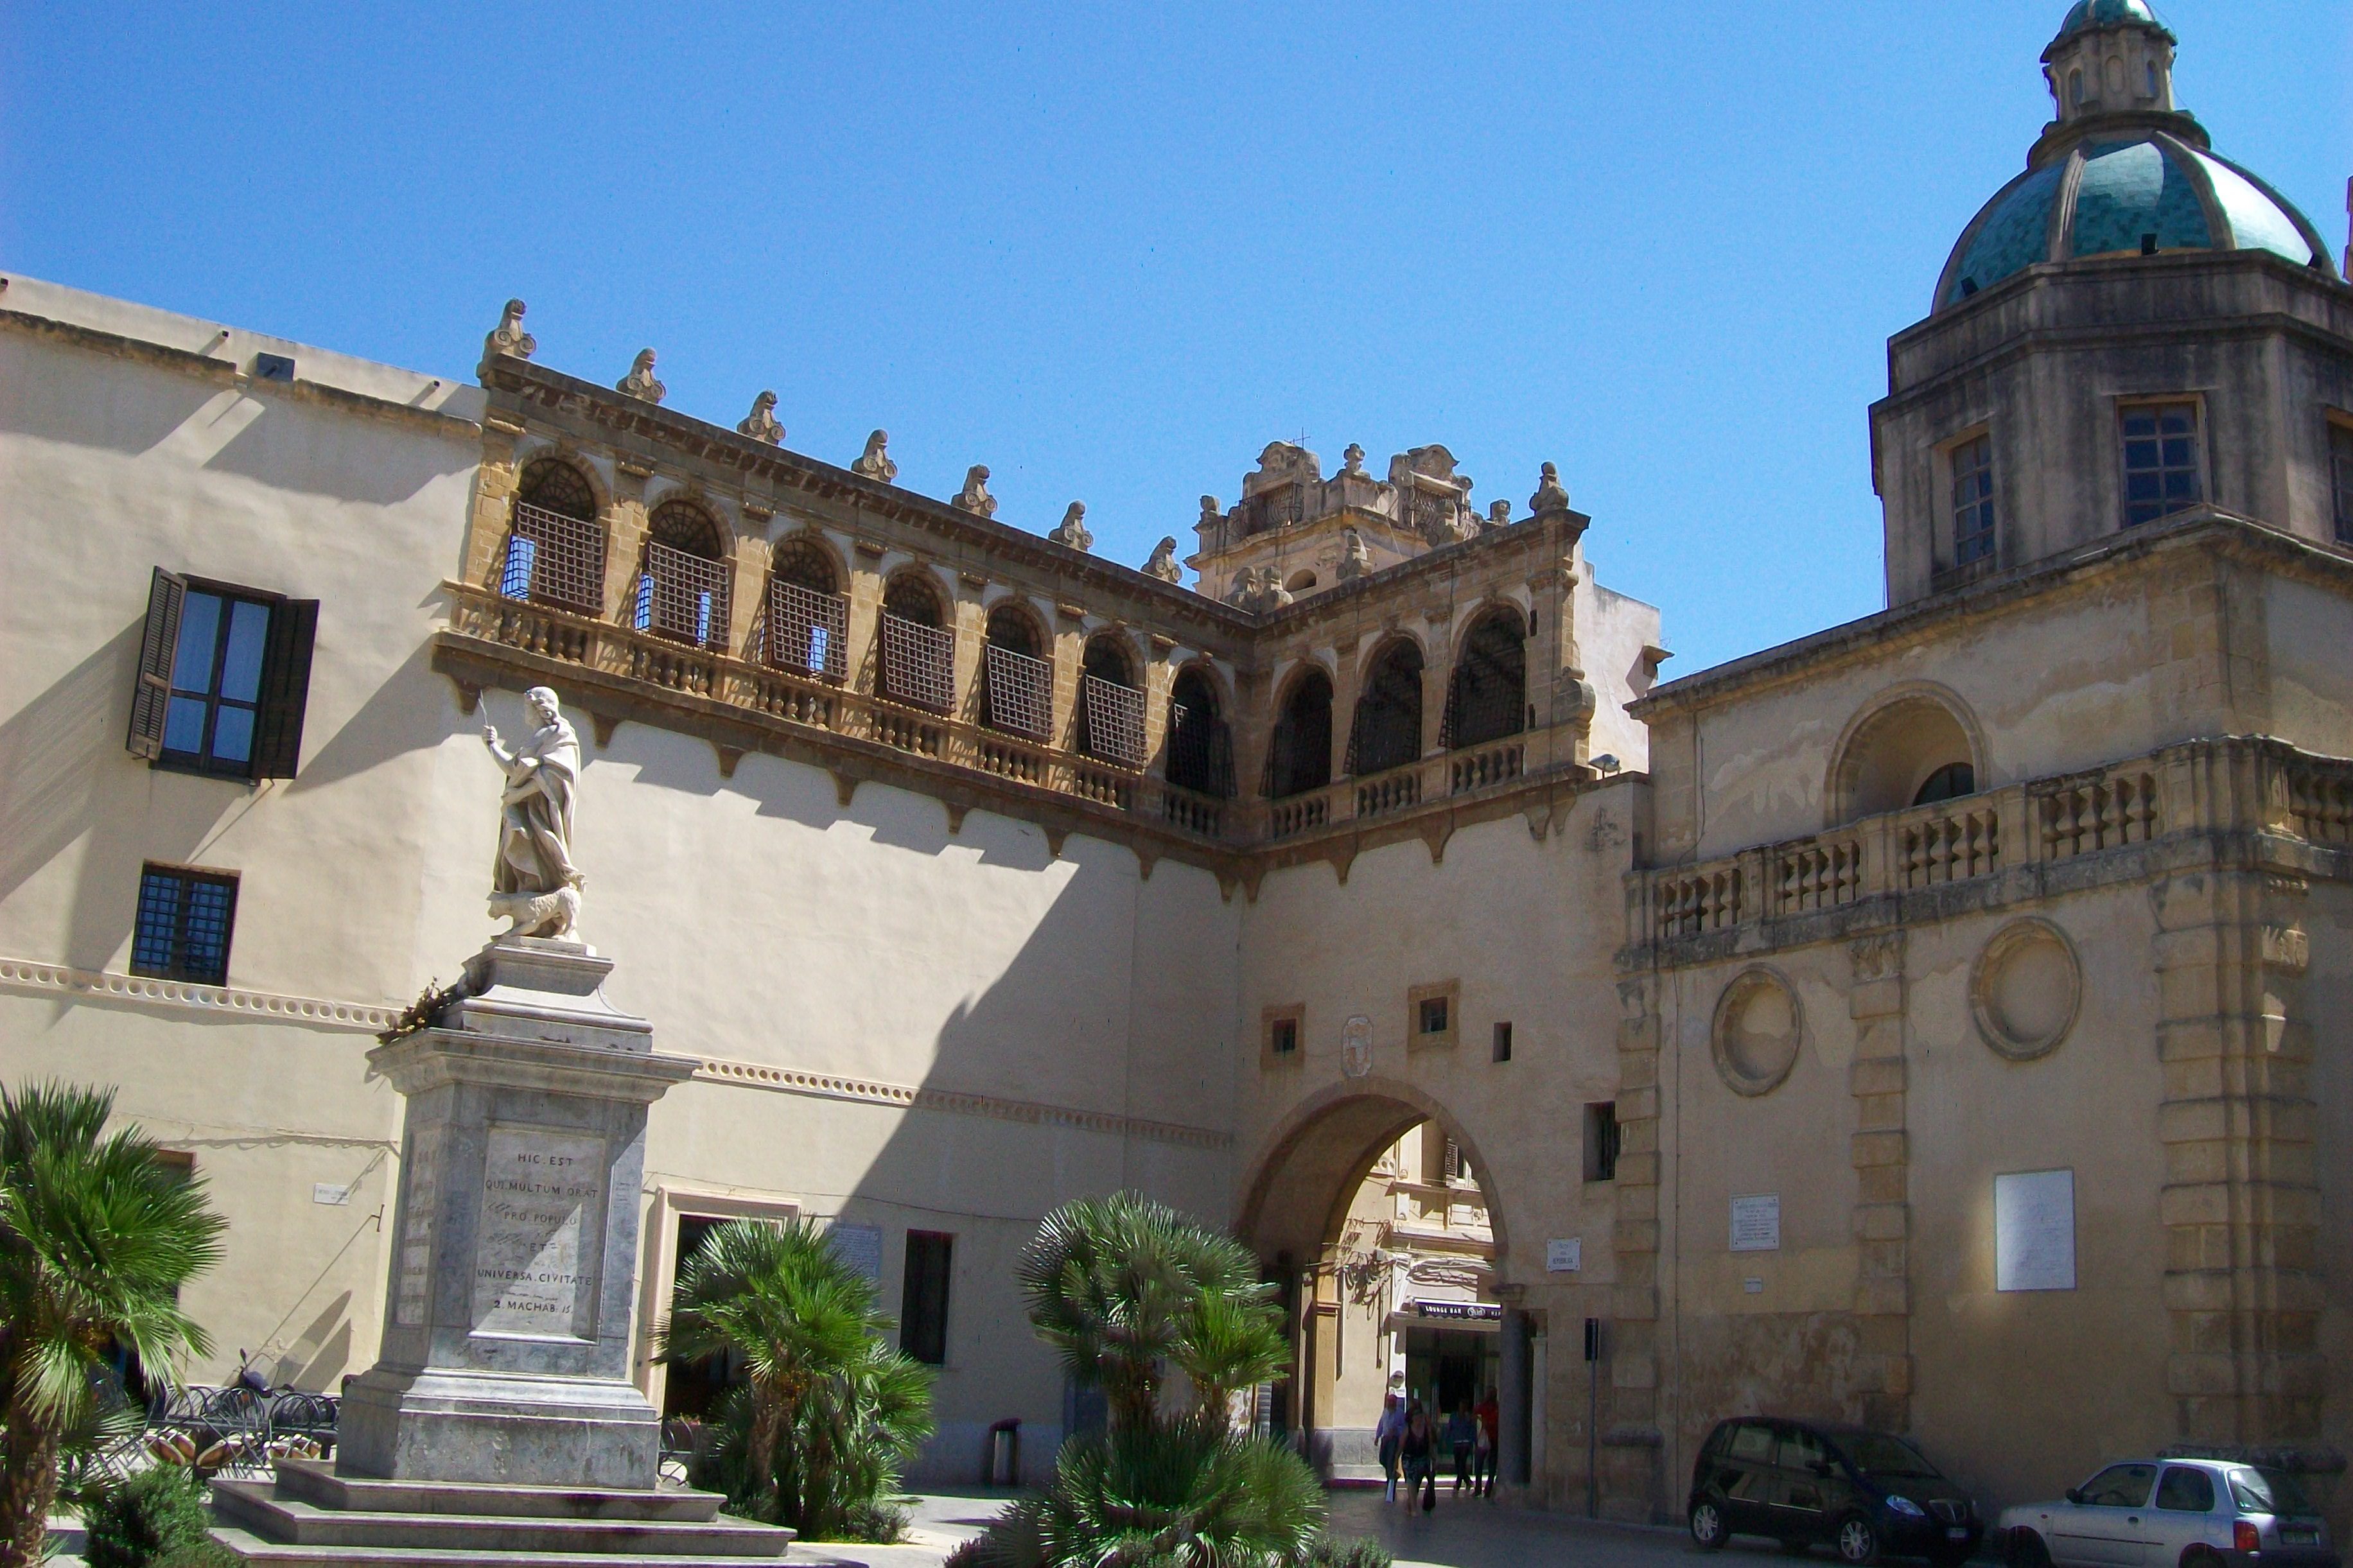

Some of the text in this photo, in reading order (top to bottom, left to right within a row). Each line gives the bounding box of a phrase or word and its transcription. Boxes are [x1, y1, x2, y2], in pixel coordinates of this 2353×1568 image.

[550, 1156, 573, 1166] EST
[509, 1182, 561, 1194] MULTUM
[567, 1187, 598, 1198] ORAT
[539, 1273, 592, 1285] CIVITATE
[1425, 1305, 1448, 1314] LOUNGE
